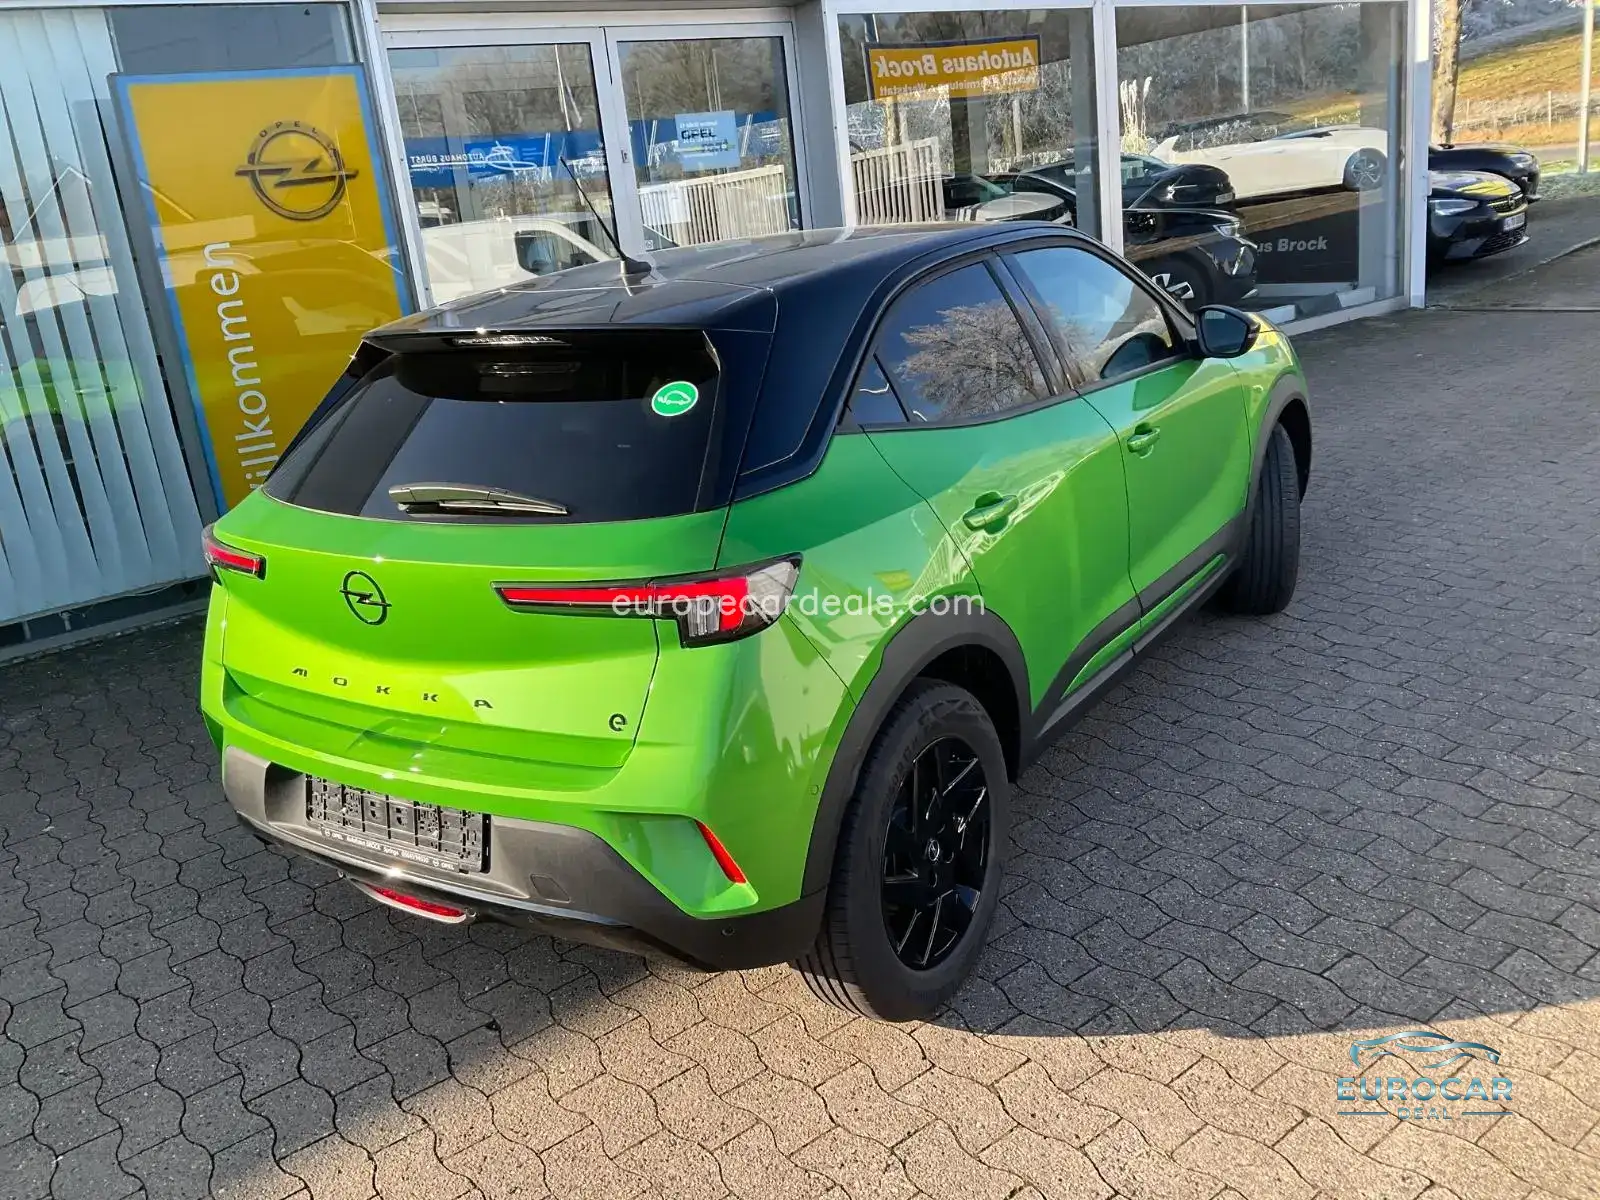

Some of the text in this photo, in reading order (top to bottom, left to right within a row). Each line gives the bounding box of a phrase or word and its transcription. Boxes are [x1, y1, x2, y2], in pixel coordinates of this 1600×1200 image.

[259, 120, 319, 139] OPEL
[1277, 236, 1328, 252] Brock
[203, 241, 279, 490] illkommen
[292, 666, 494, 709] MOKKA
